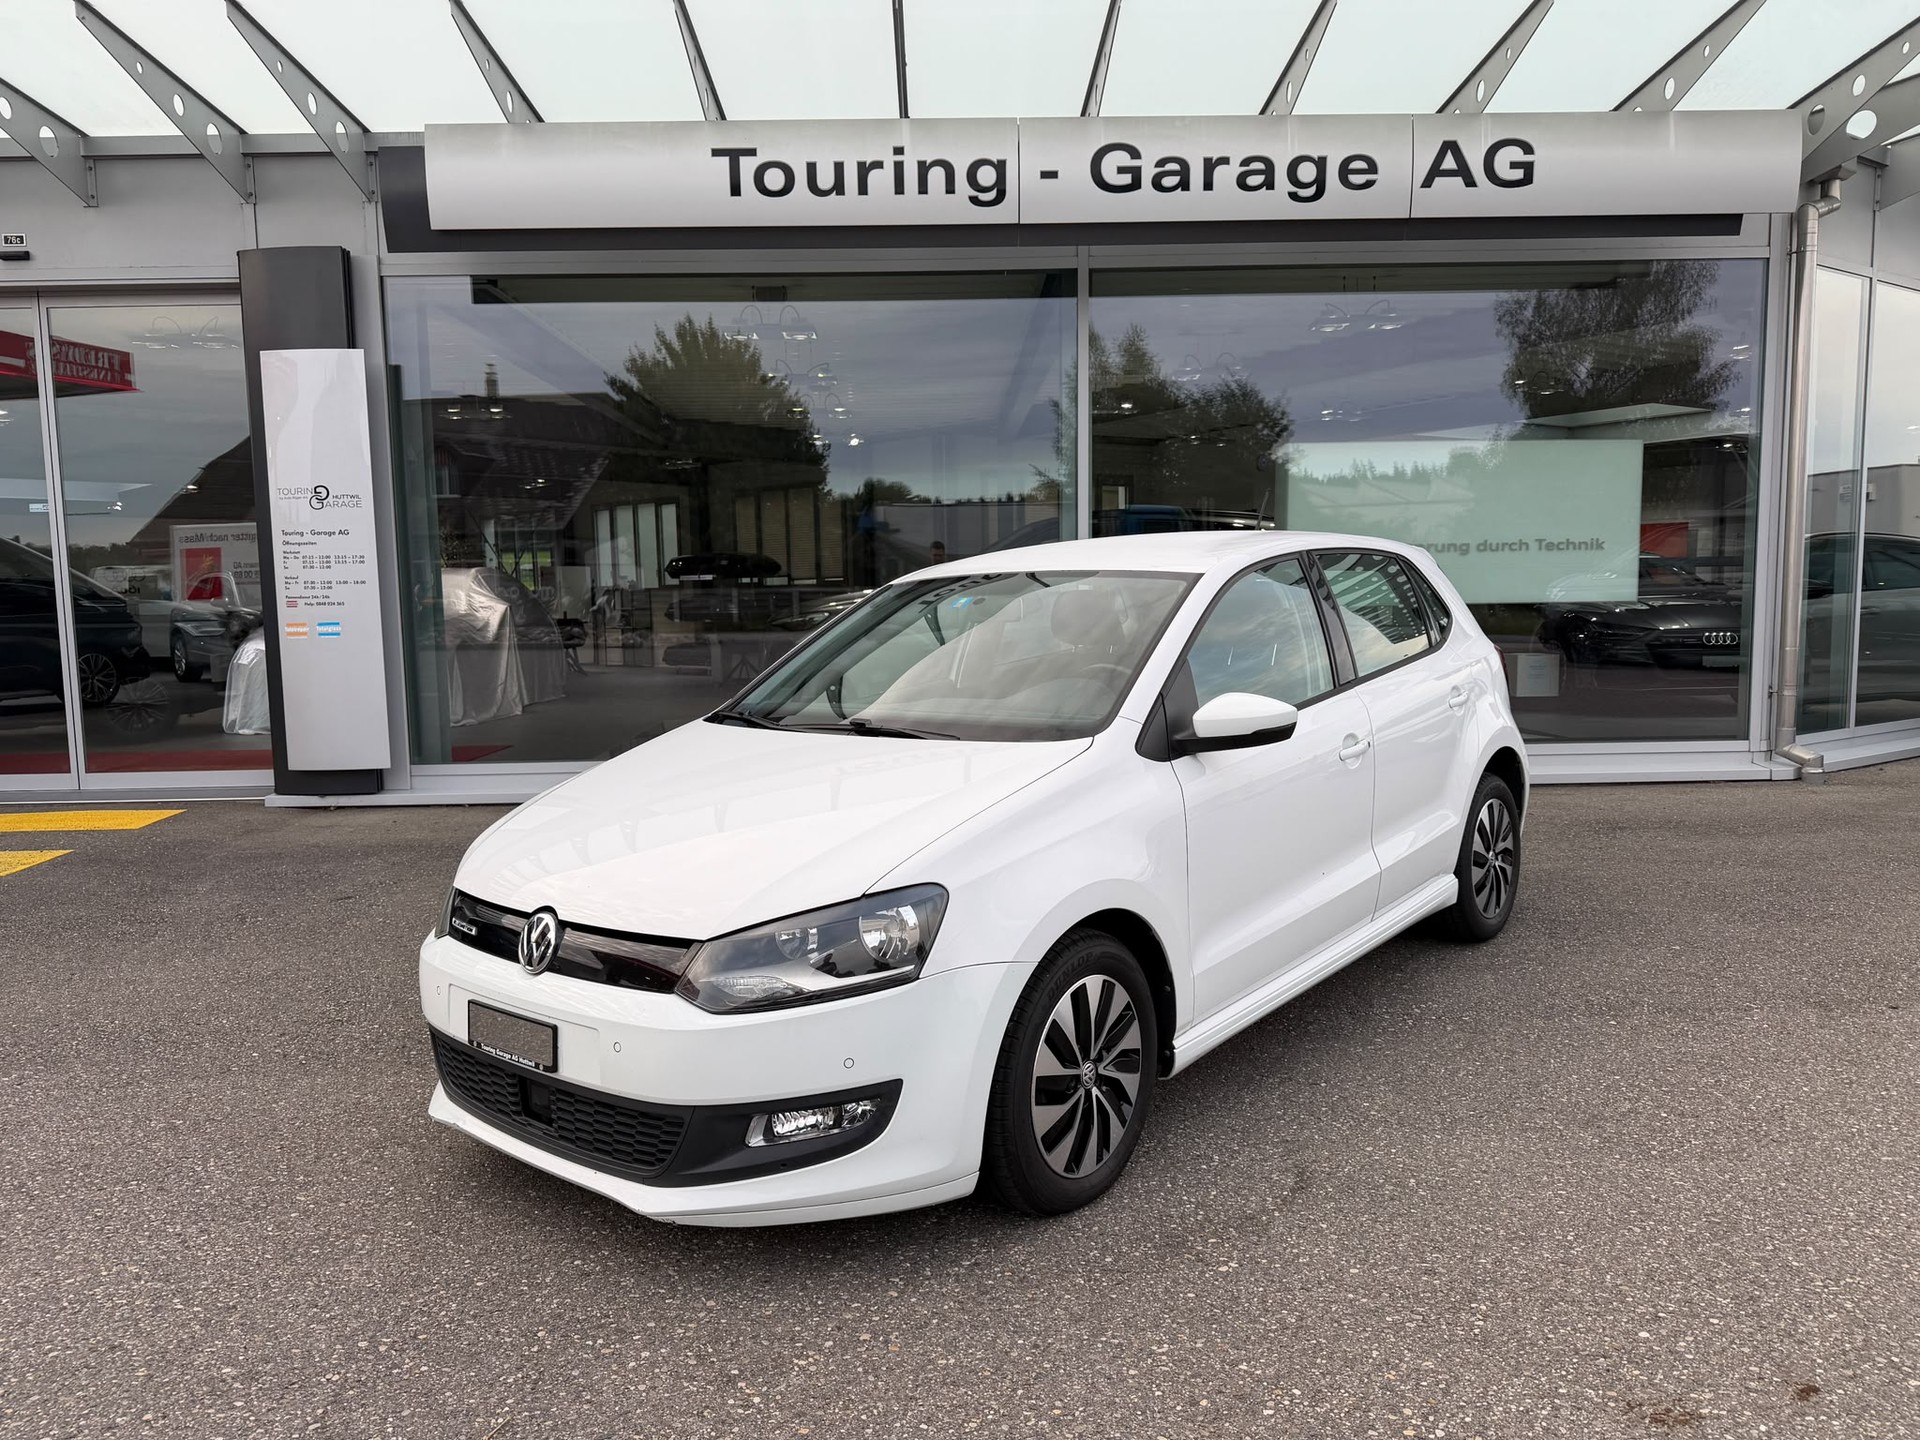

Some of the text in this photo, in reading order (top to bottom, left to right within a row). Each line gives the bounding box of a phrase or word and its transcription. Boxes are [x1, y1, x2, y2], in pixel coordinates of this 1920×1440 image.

[711, 138, 1536, 207] Touring - Garage AG
[6, 236, 21, 244] 76c
[310, 529, 336, 537] Garage
[1476, 539, 1529, 552] durch
[1535, 538, 1606, 552] Technik
